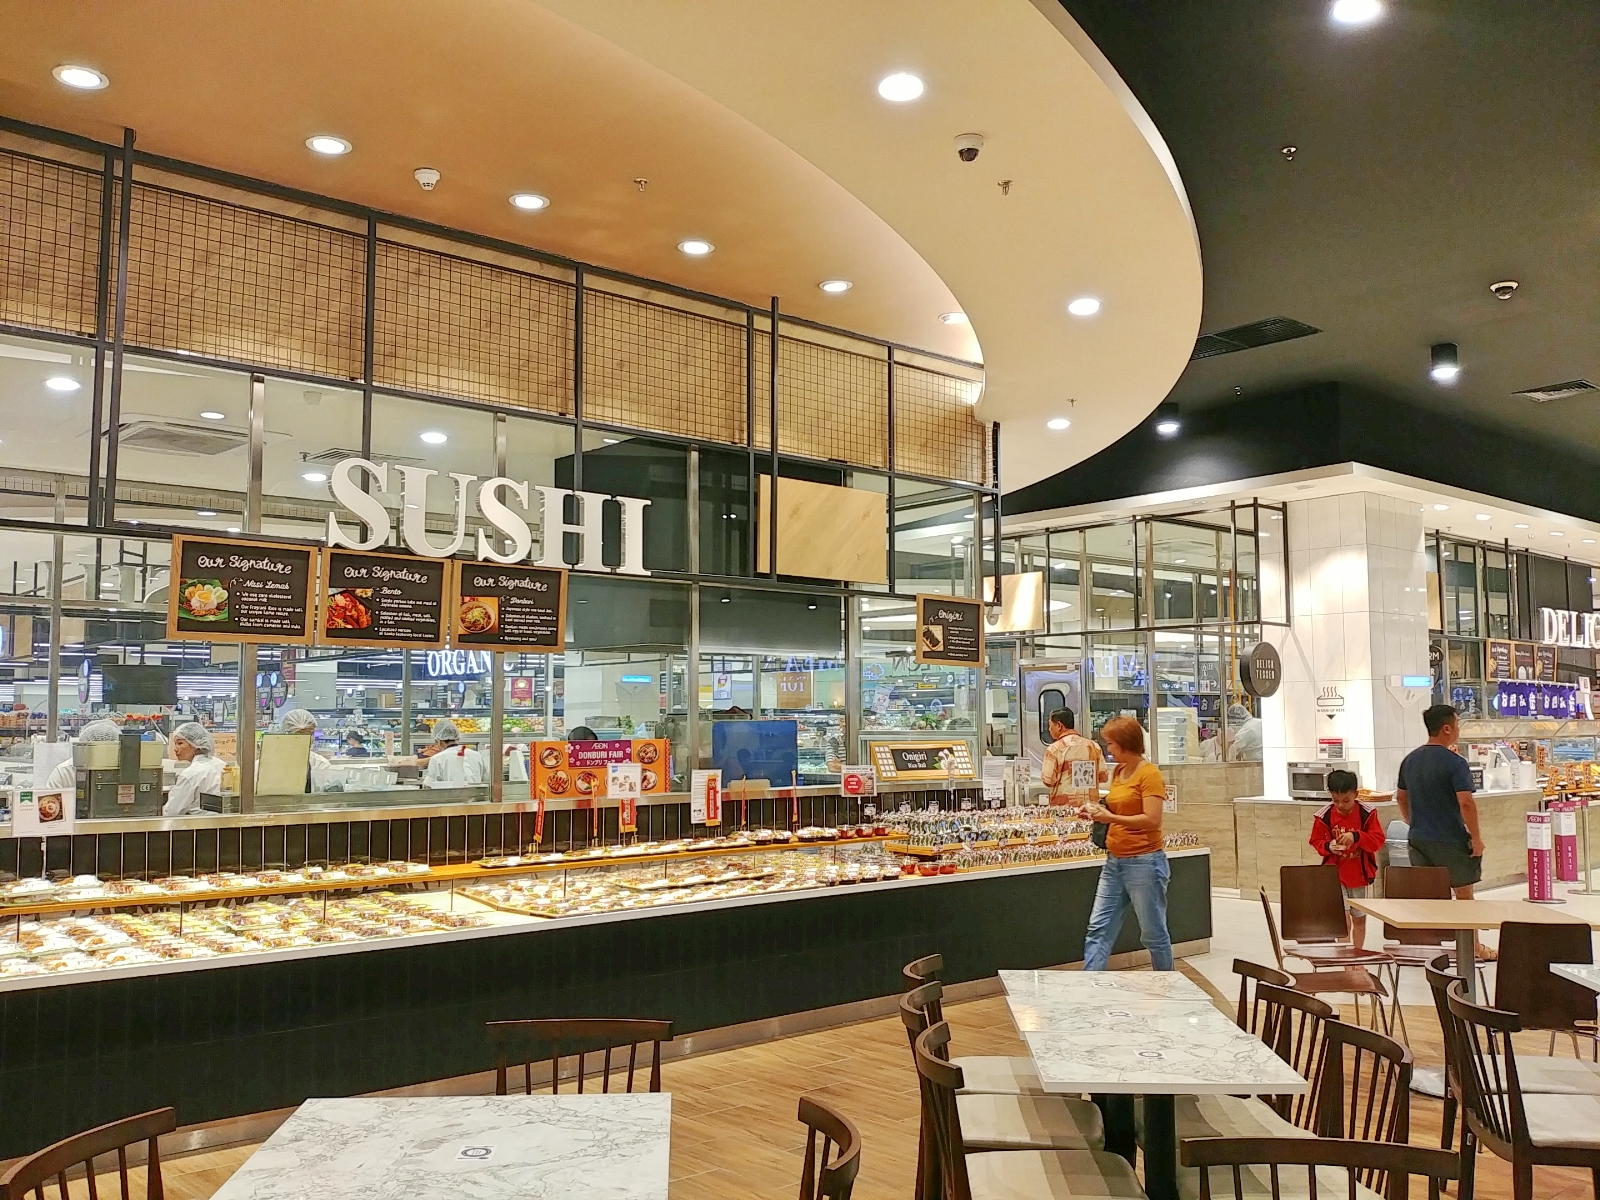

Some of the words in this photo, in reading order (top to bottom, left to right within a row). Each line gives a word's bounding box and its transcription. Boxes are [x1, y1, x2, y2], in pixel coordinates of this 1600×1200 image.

[327, 457, 652, 577] SUSHI
[197, 555, 227, 568] Our
[228, 555, 293, 574] Signature
[343, 566, 370, 578] Our
[371, 565, 429, 584] Signature
[243, 579, 264, 588] Nasi
[264, 580, 290, 590] Lemak
[473, 576, 497, 587] Our
[497, 575, 549, 592] Signature
[380, 586, 402, 596] Bento
[1256, 659, 1274, 668] DELICA
[578, 751, 608, 759] DONBURI
[609, 750, 624, 758] FAIR
[902, 752, 927, 762] Onigiri
